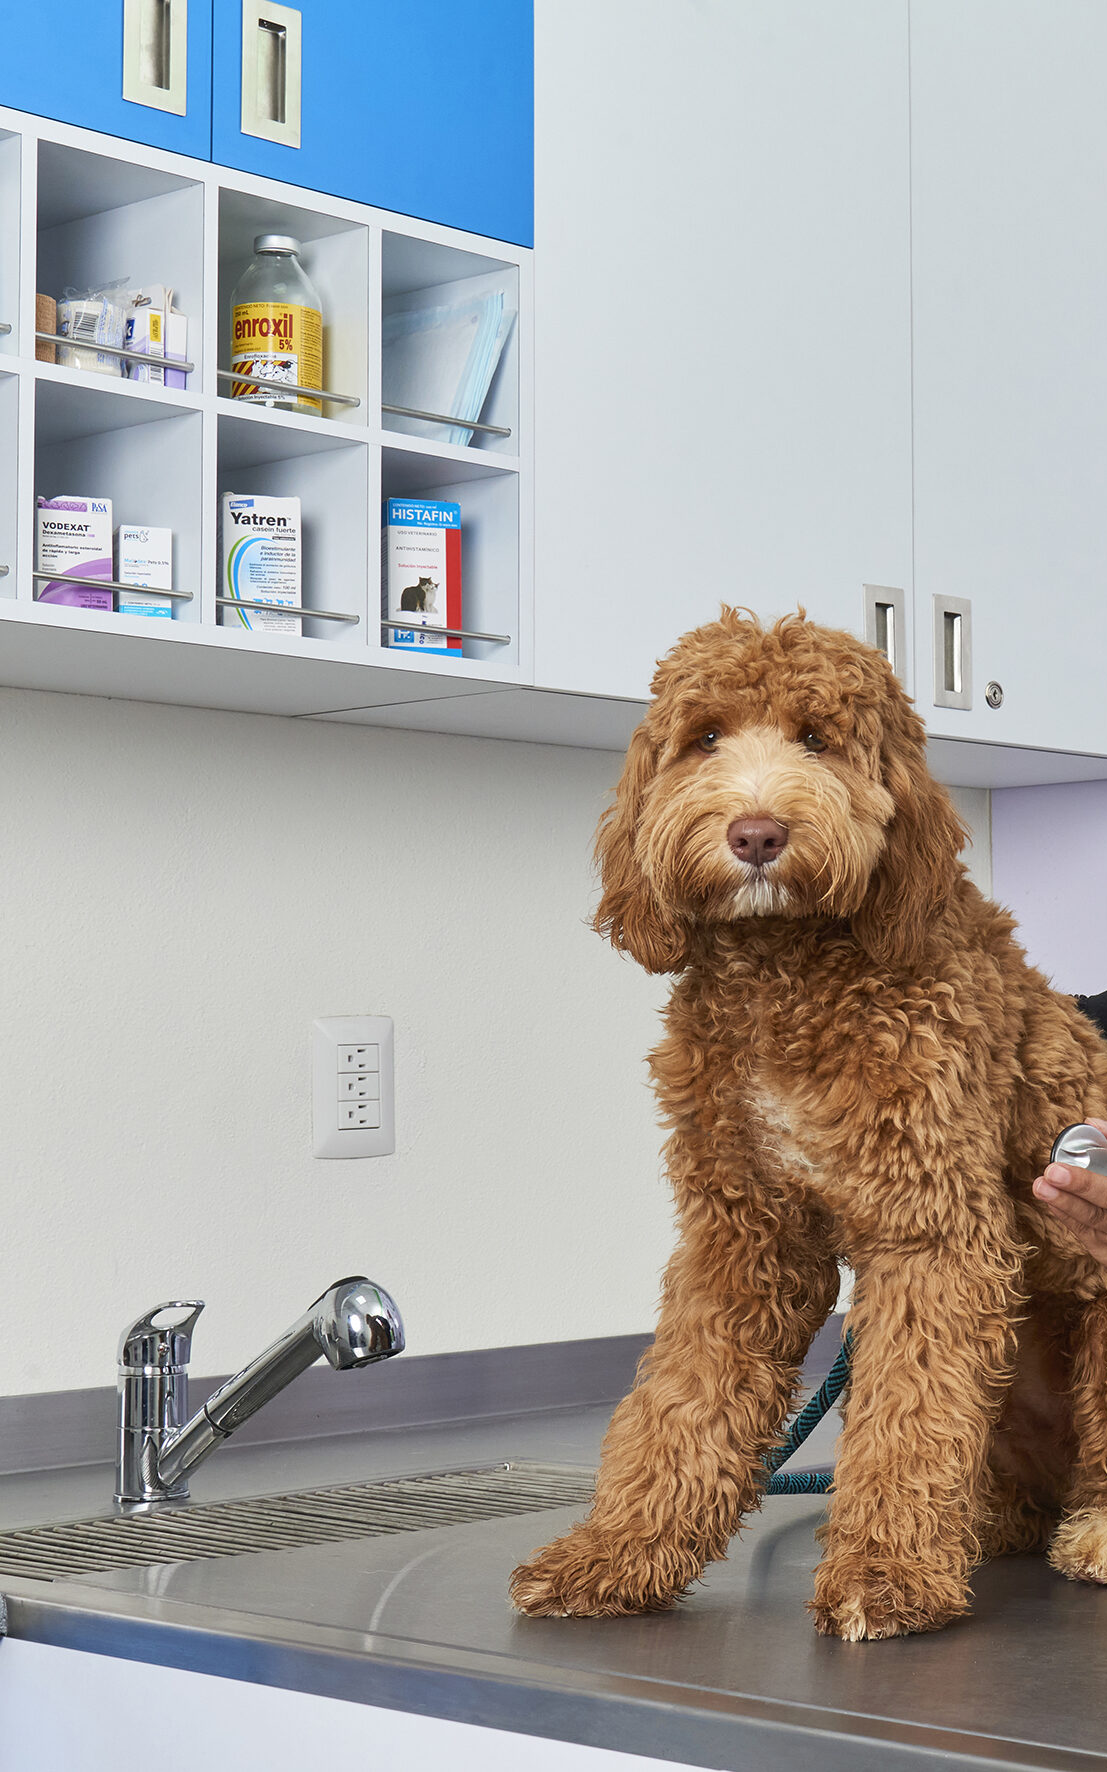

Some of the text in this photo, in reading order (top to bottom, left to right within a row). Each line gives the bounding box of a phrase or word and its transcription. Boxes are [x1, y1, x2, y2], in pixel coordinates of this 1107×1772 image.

[235, 313, 293, 340] enroxil
[279, 339, 293, 350] 5%
[231, 512, 287, 527] Yatren
[392, 508, 453, 522] HISTAFIN
[42, 521, 89, 532] VODEXAT
